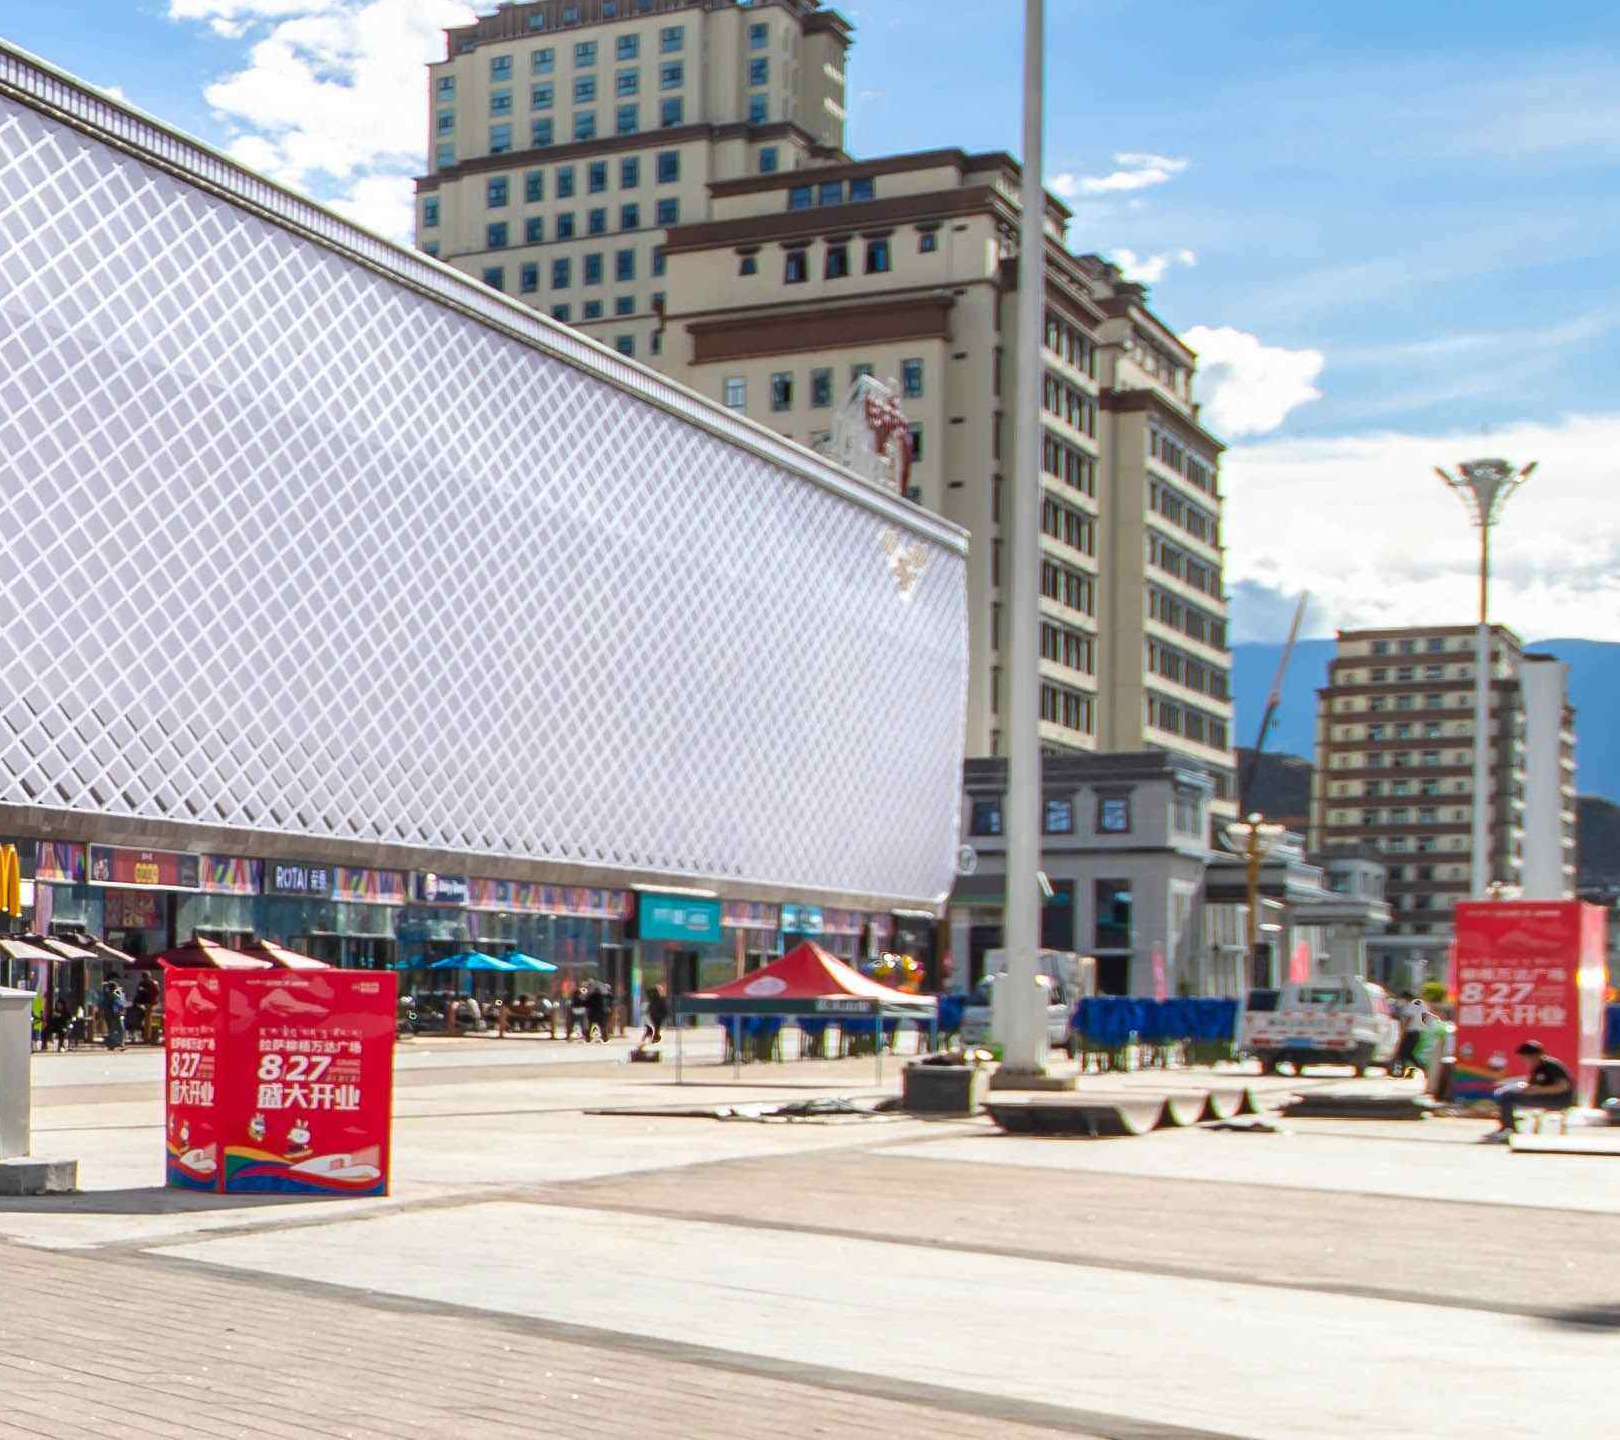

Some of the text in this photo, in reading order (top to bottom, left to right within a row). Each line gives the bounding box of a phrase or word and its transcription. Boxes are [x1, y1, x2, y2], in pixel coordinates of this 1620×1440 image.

[275, 865, 308, 890] ROTAI
[256, 1083, 360, 1111] 盛大开业
